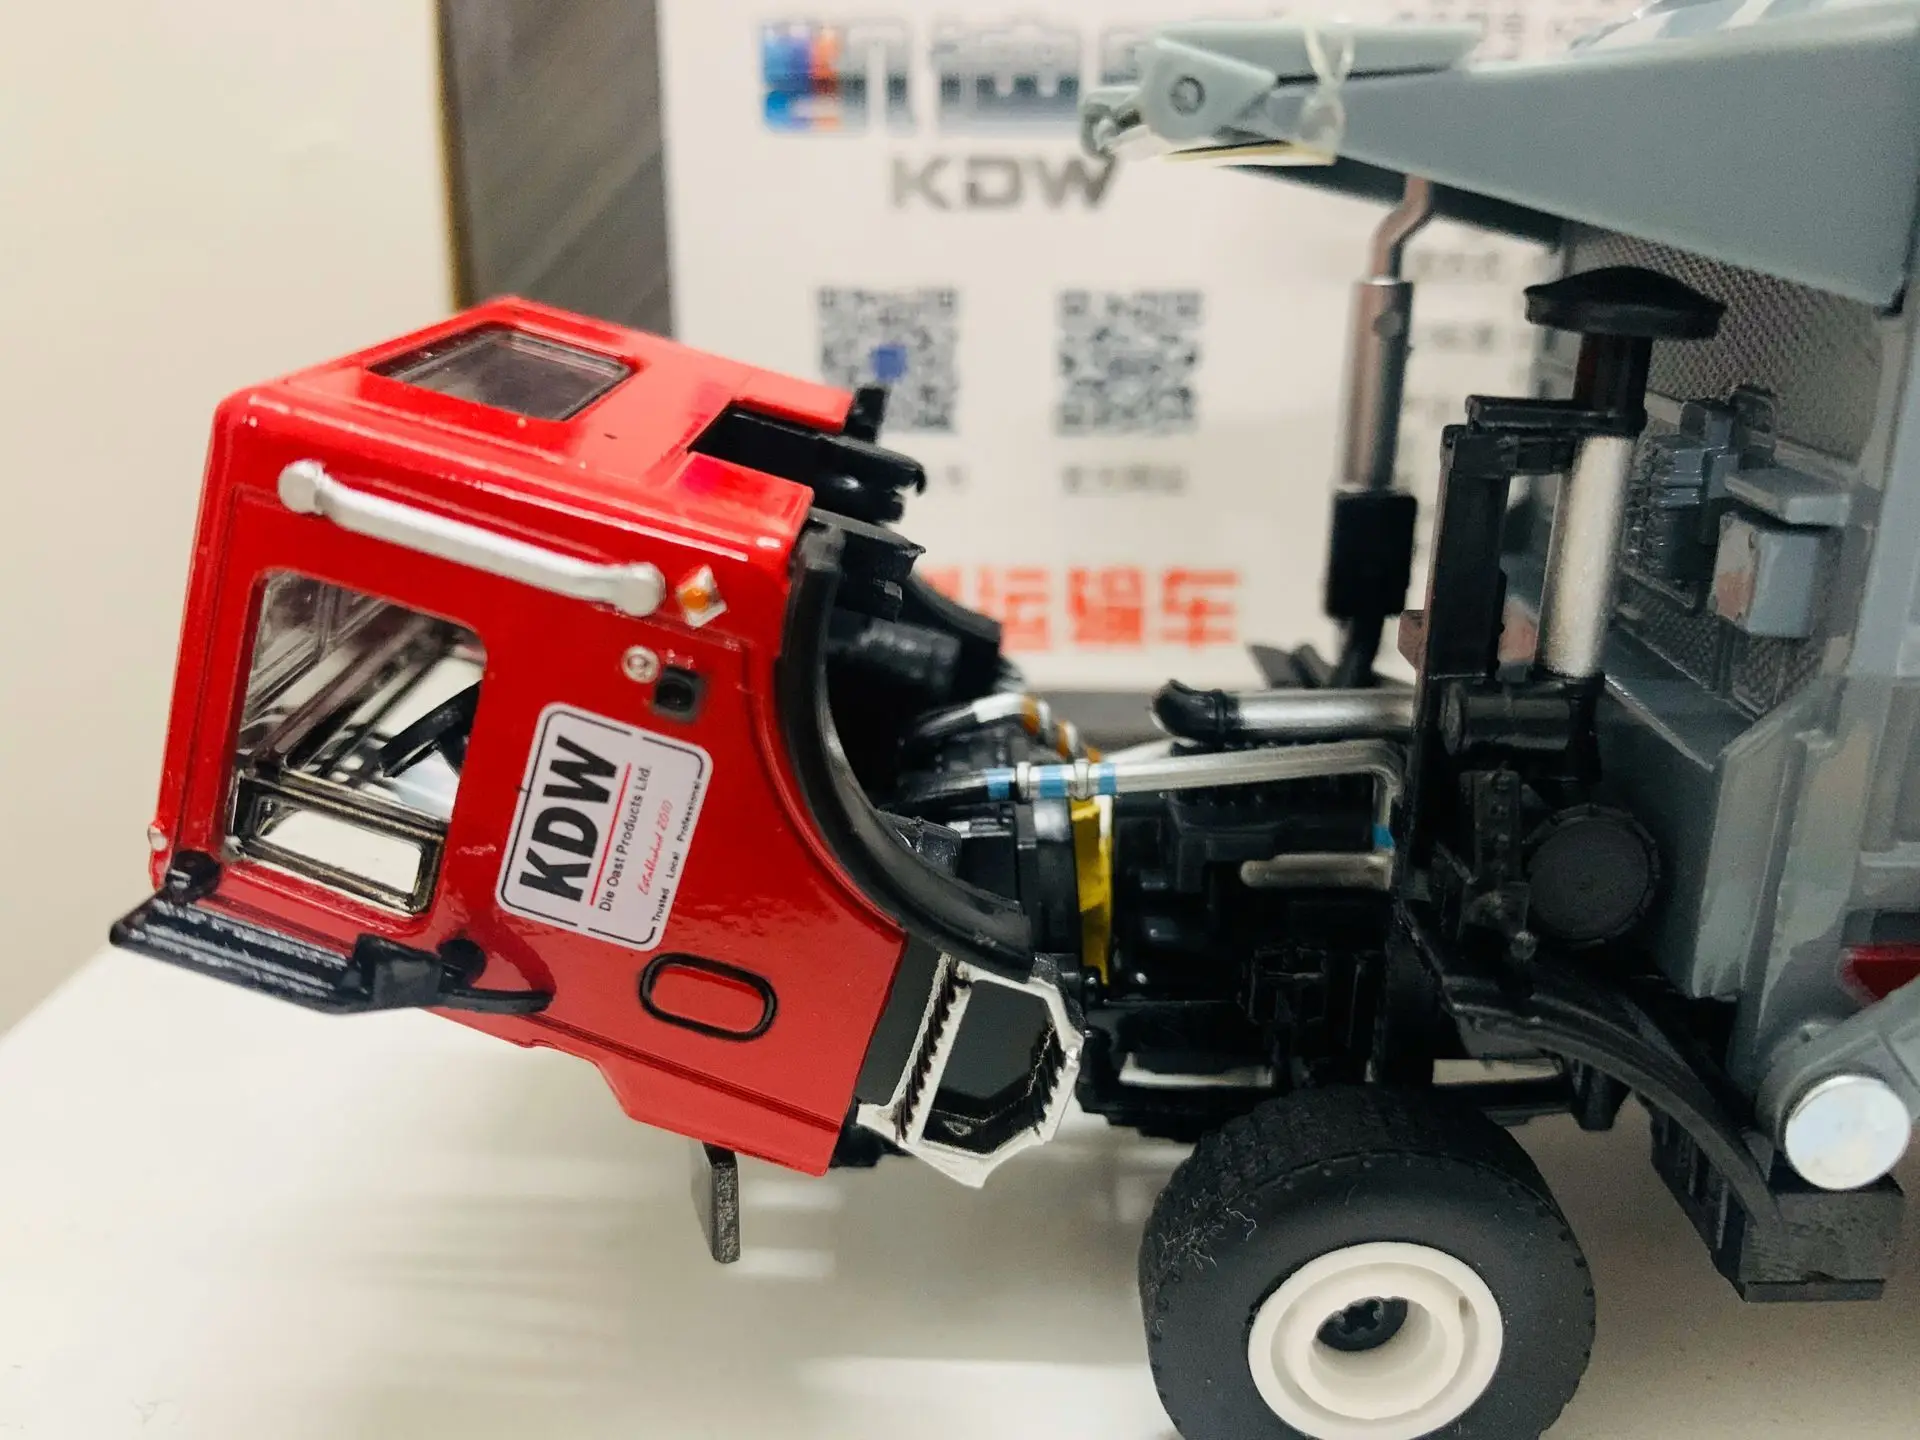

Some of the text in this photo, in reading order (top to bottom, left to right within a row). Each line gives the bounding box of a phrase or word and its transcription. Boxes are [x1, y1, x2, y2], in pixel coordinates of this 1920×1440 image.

[892, 153, 1116, 208] KDW
[519, 735, 617, 902] KDW
[599, 891, 615, 912] Die
[616, 795, 642, 855] Products
[652, 780, 701, 922] Trusted Local Professional
